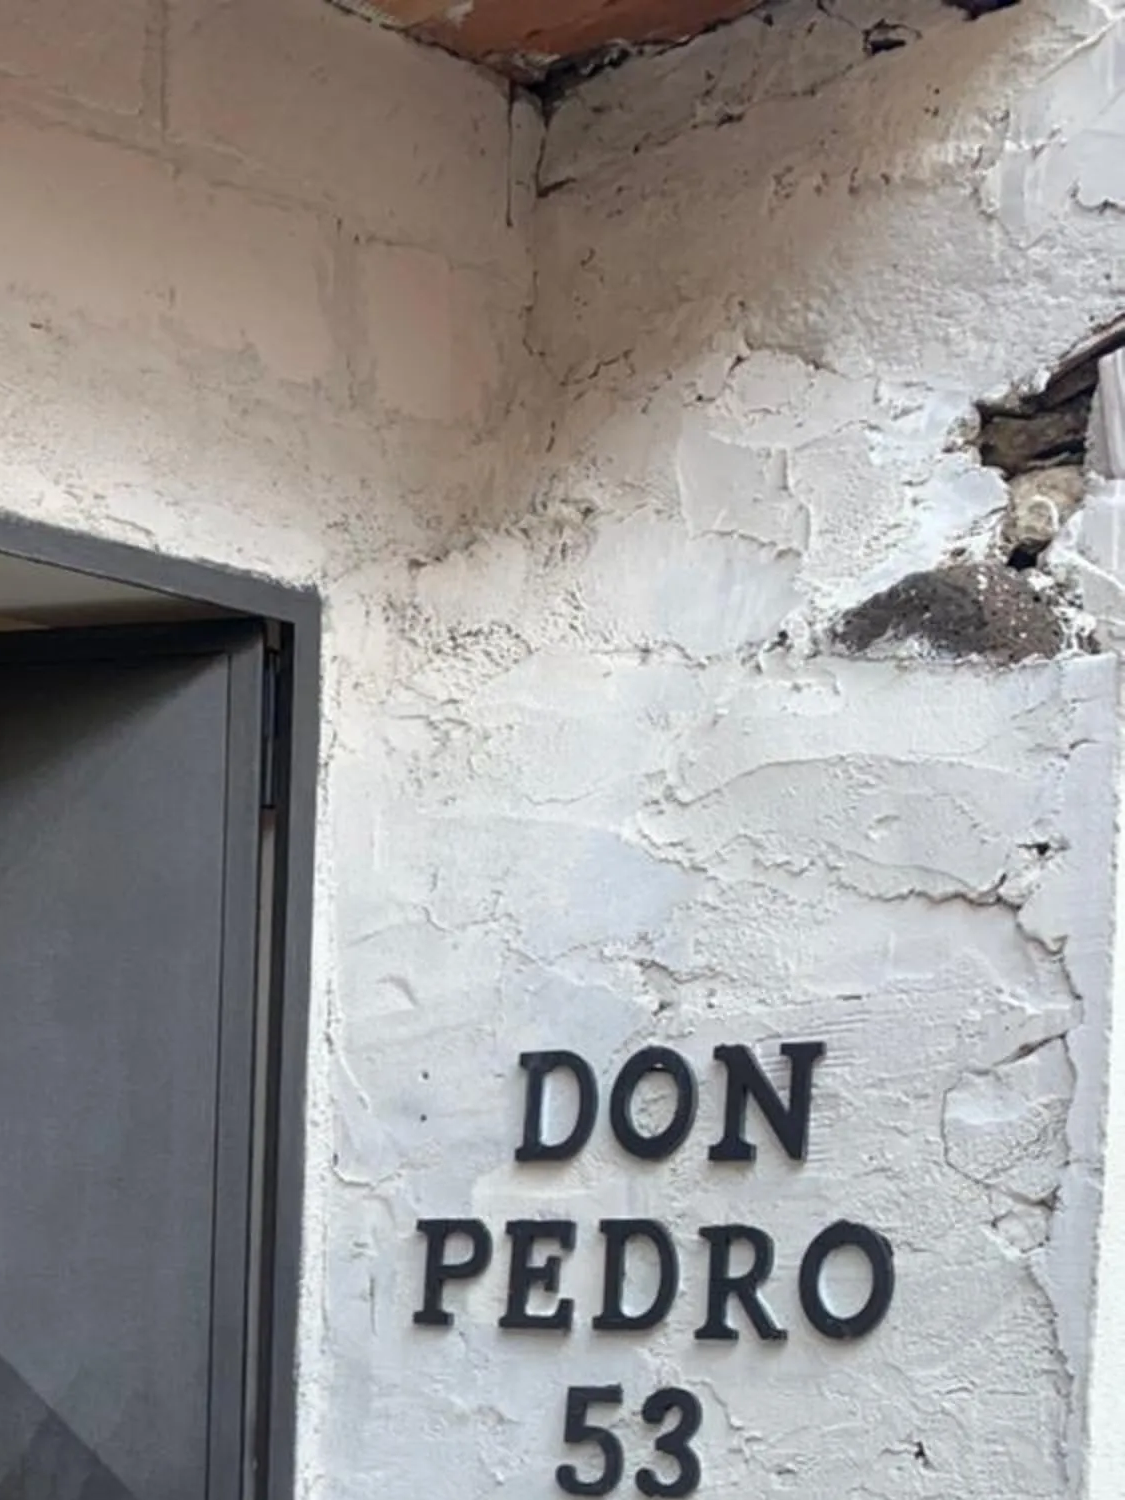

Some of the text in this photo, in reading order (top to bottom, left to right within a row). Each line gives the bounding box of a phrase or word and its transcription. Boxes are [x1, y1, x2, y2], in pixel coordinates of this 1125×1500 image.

[514, 1041, 826, 1164] DON
[413, 1219, 895, 1342] PEDRO
[555, 1385, 703, 1500] 53
